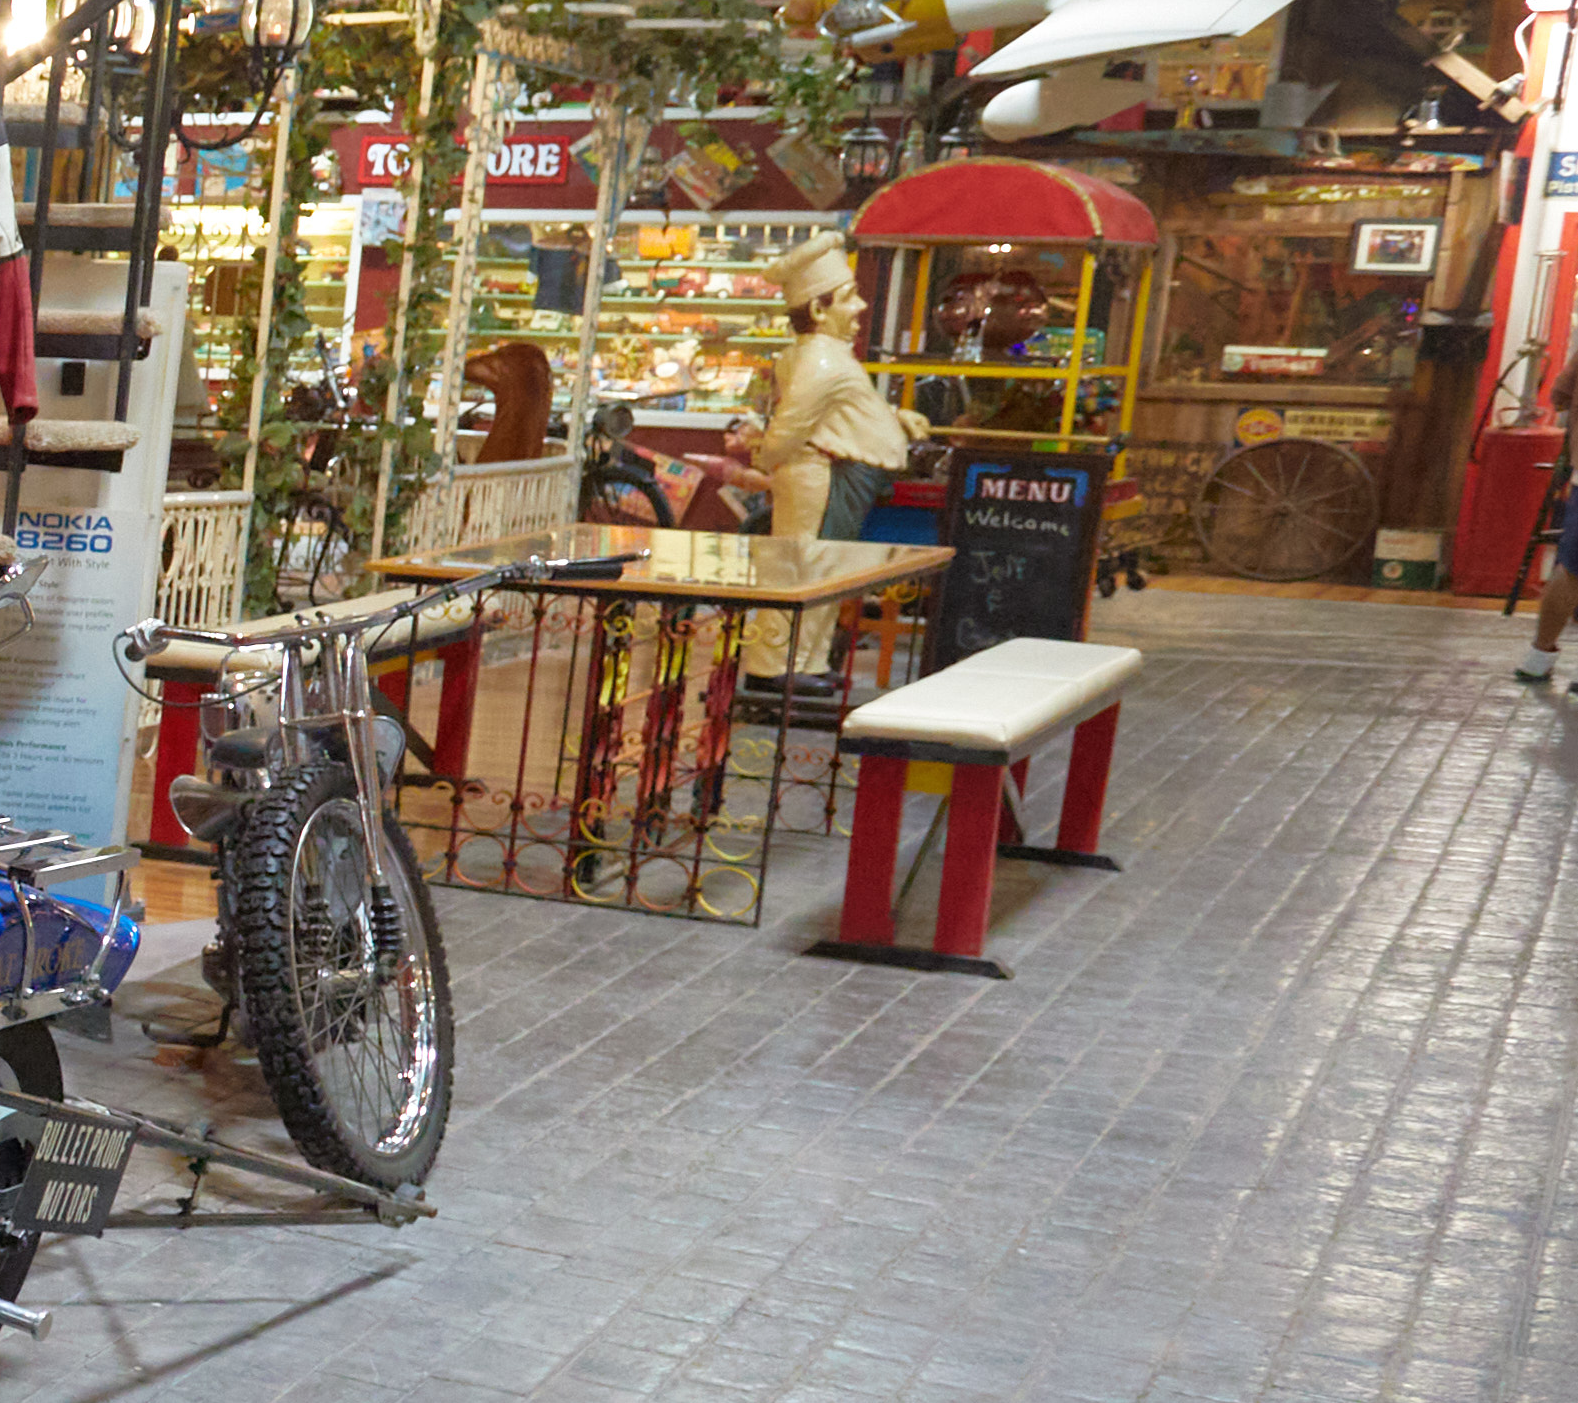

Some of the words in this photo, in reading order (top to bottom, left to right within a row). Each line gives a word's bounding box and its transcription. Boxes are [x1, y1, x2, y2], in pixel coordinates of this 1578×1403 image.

[485, 142, 562, 177] ORE
[980, 478, 1074, 503] MENU
[18, 511, 113, 531] NOKIA
[965, 507, 1070, 537] Welcome
[16, 530, 113, 554] 8260
[85, 557, 111, 570] Style
[34, 1119, 94, 1167] BULLET
[85, 1127, 133, 1171] PROOF
[34, 1179, 100, 1225] MOTORS
